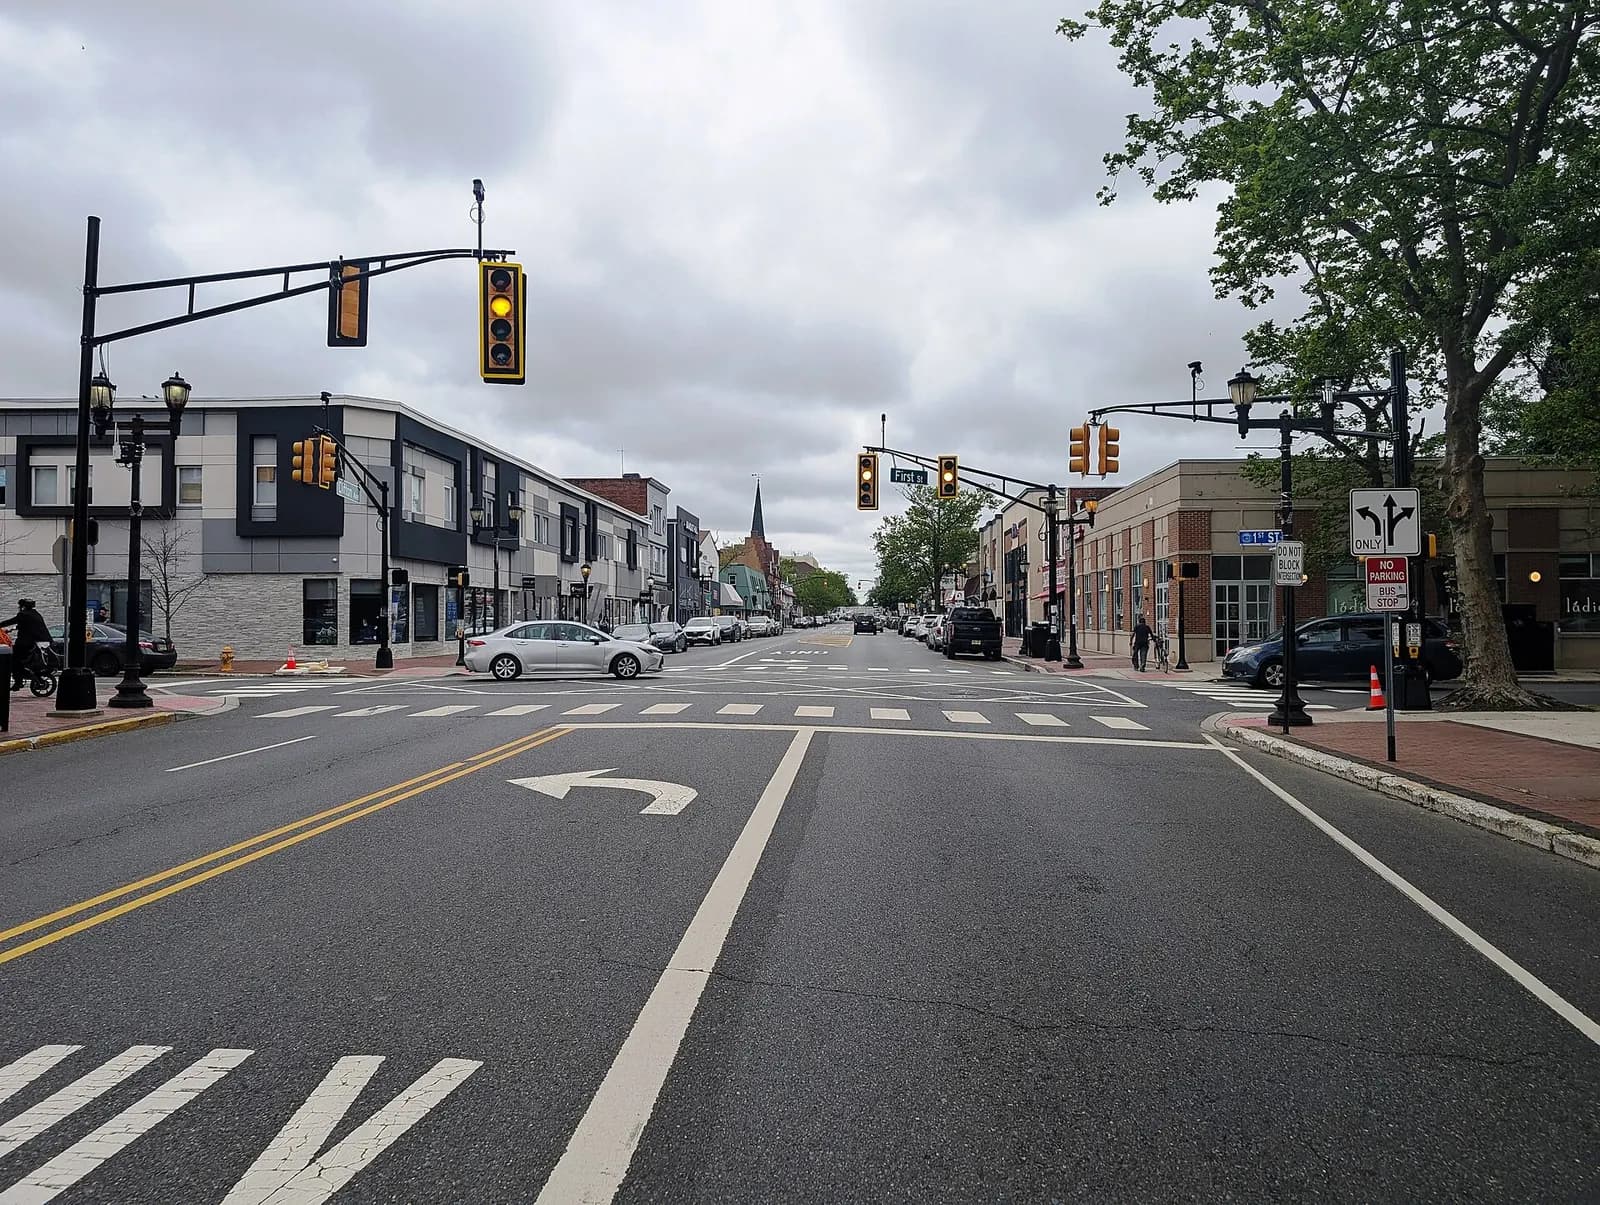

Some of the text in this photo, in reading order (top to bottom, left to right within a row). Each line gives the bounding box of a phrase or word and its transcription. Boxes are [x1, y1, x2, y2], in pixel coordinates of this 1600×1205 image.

[895, 470, 924, 483] First St
[1267, 532, 1280, 543] ST
[1355, 539, 1382, 550] ONLY
[1278, 546, 1301, 557] DO NOT
[1278, 559, 1301, 570] BLOCK
[1379, 560, 1394, 570] NO
[1369, 571, 1405, 581] PARKING
[1379, 587, 1396, 596] BUS
[1377, 598, 1399, 607] STOP
